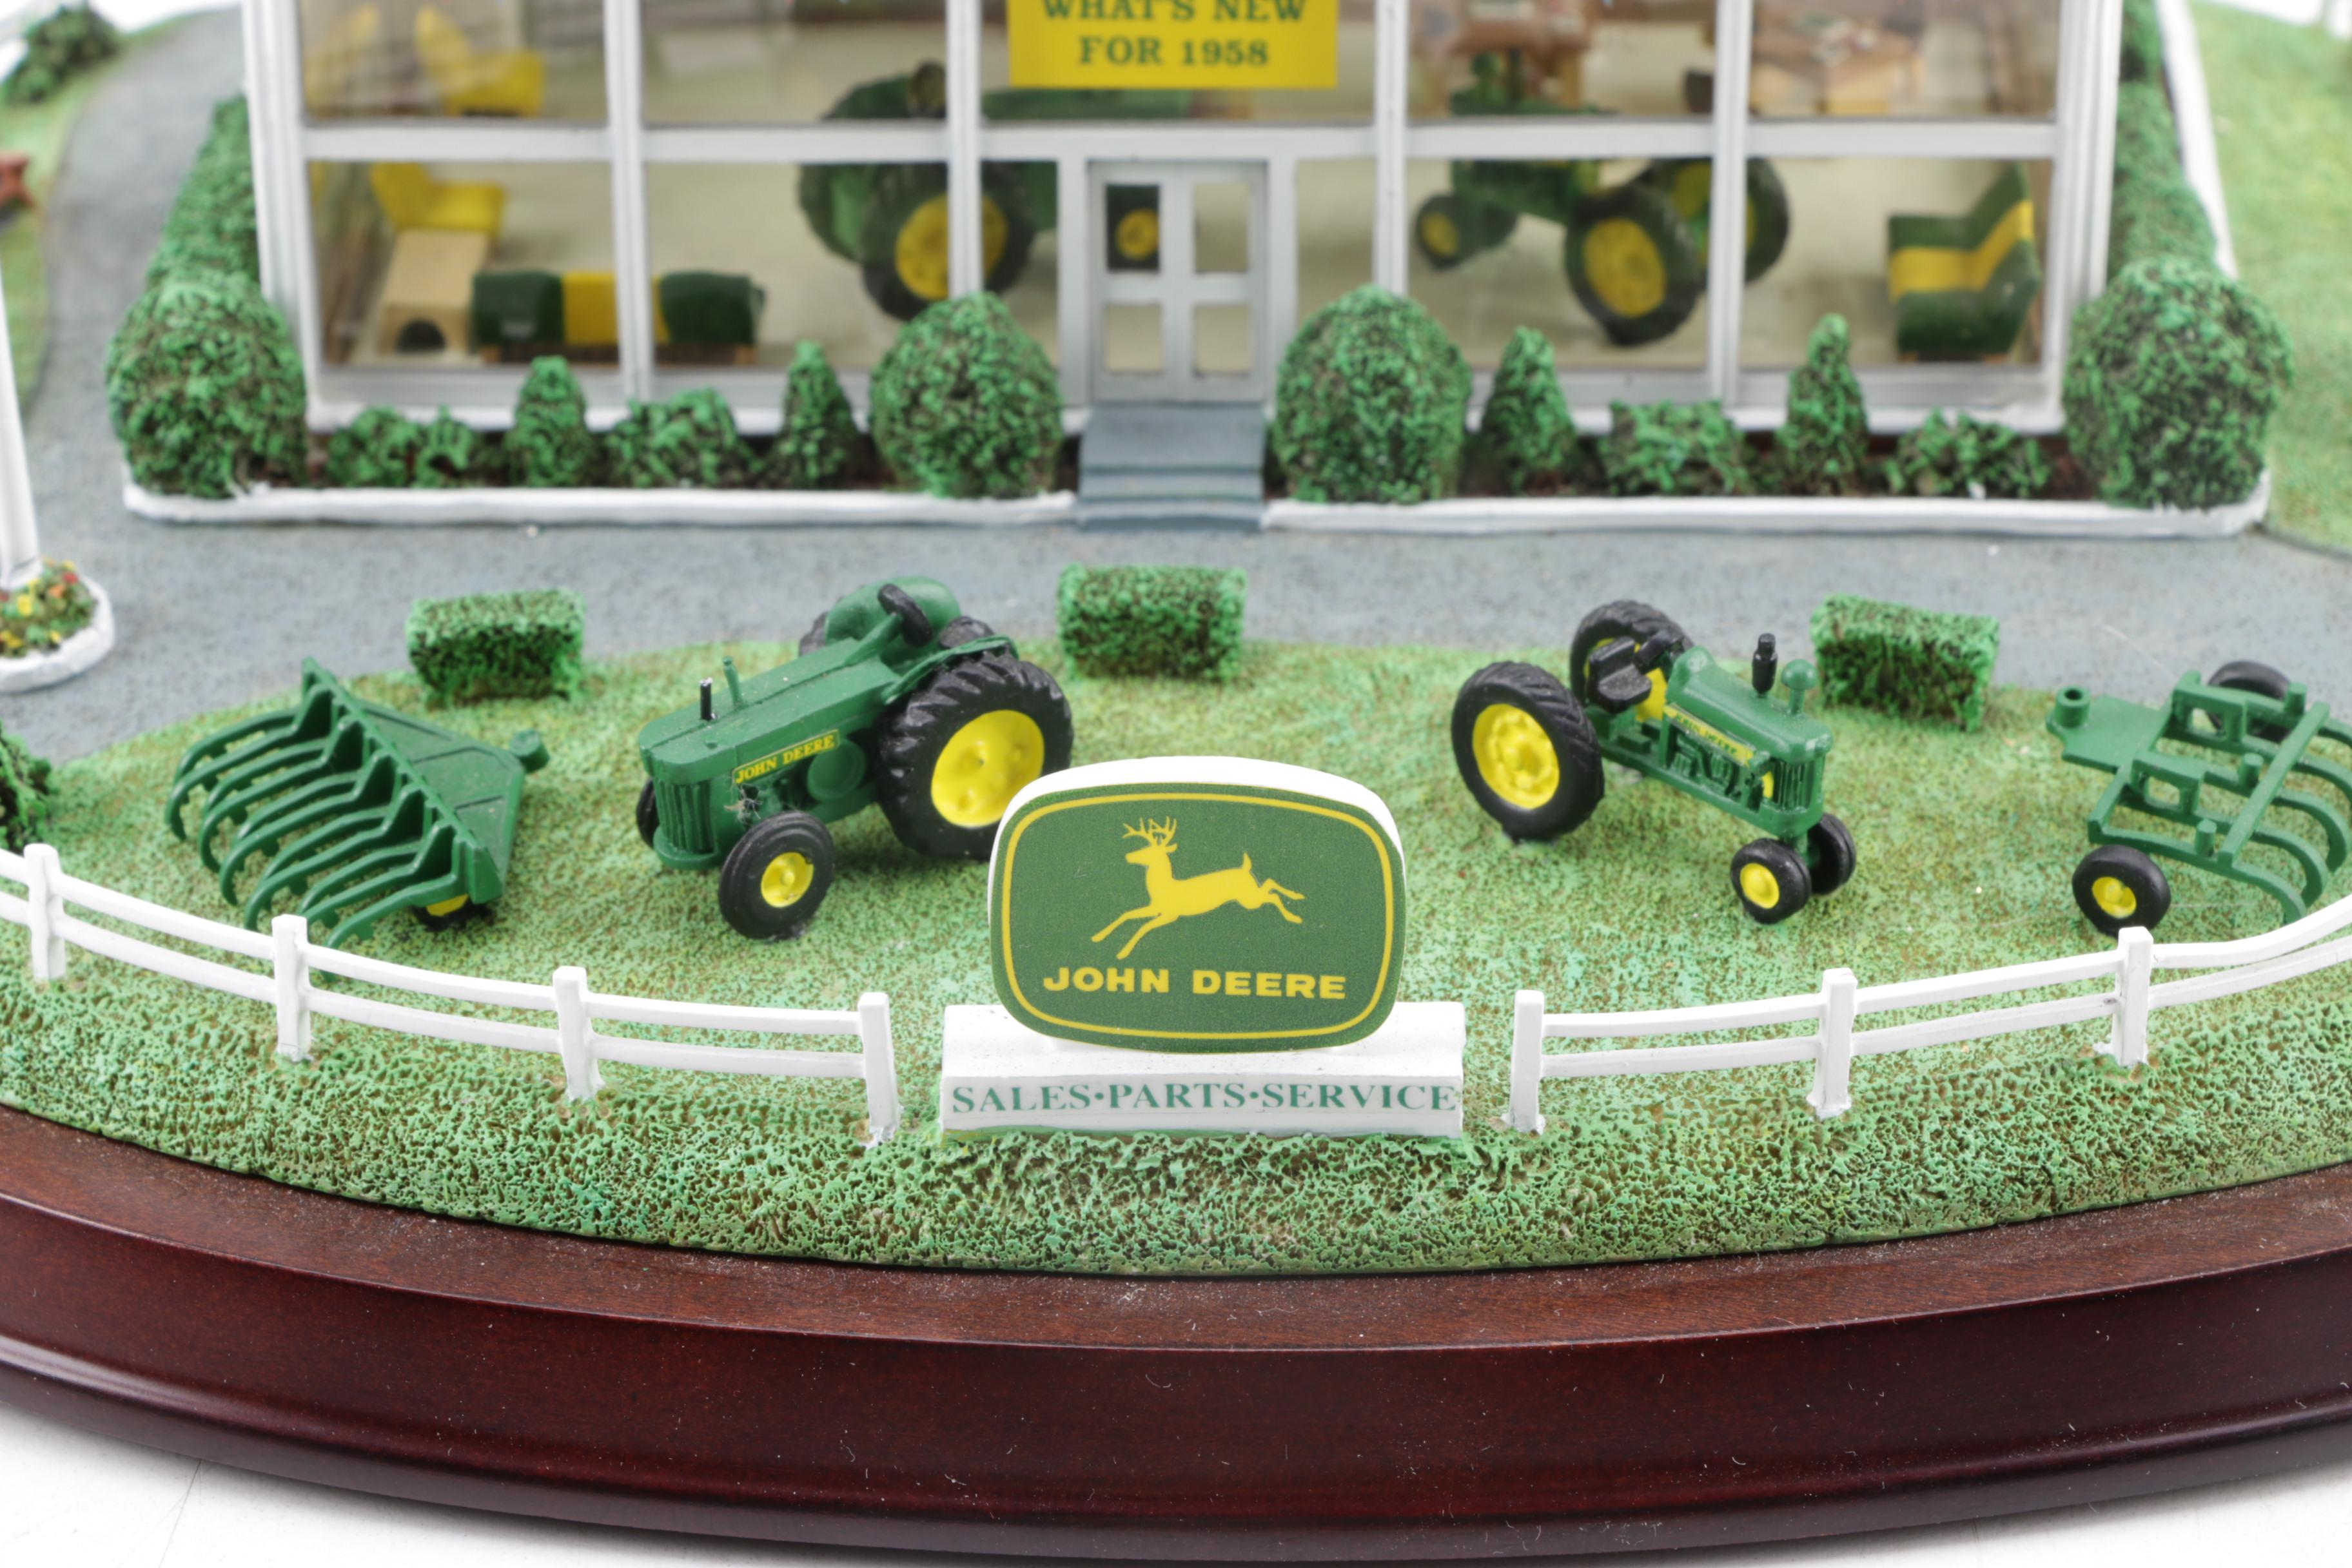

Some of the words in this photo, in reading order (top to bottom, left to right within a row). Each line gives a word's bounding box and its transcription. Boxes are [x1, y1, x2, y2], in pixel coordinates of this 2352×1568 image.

[1213, 0, 1306, 22] NEW
[1077, 37, 1163, 65] FOR
[1181, 39, 1269, 66] 1958
[736, 756, 778, 784] JOHN
[782, 734, 835, 765] DEERE
[1043, 966, 1170, 993] JOHN
[1192, 970, 1347, 999] DEERE
